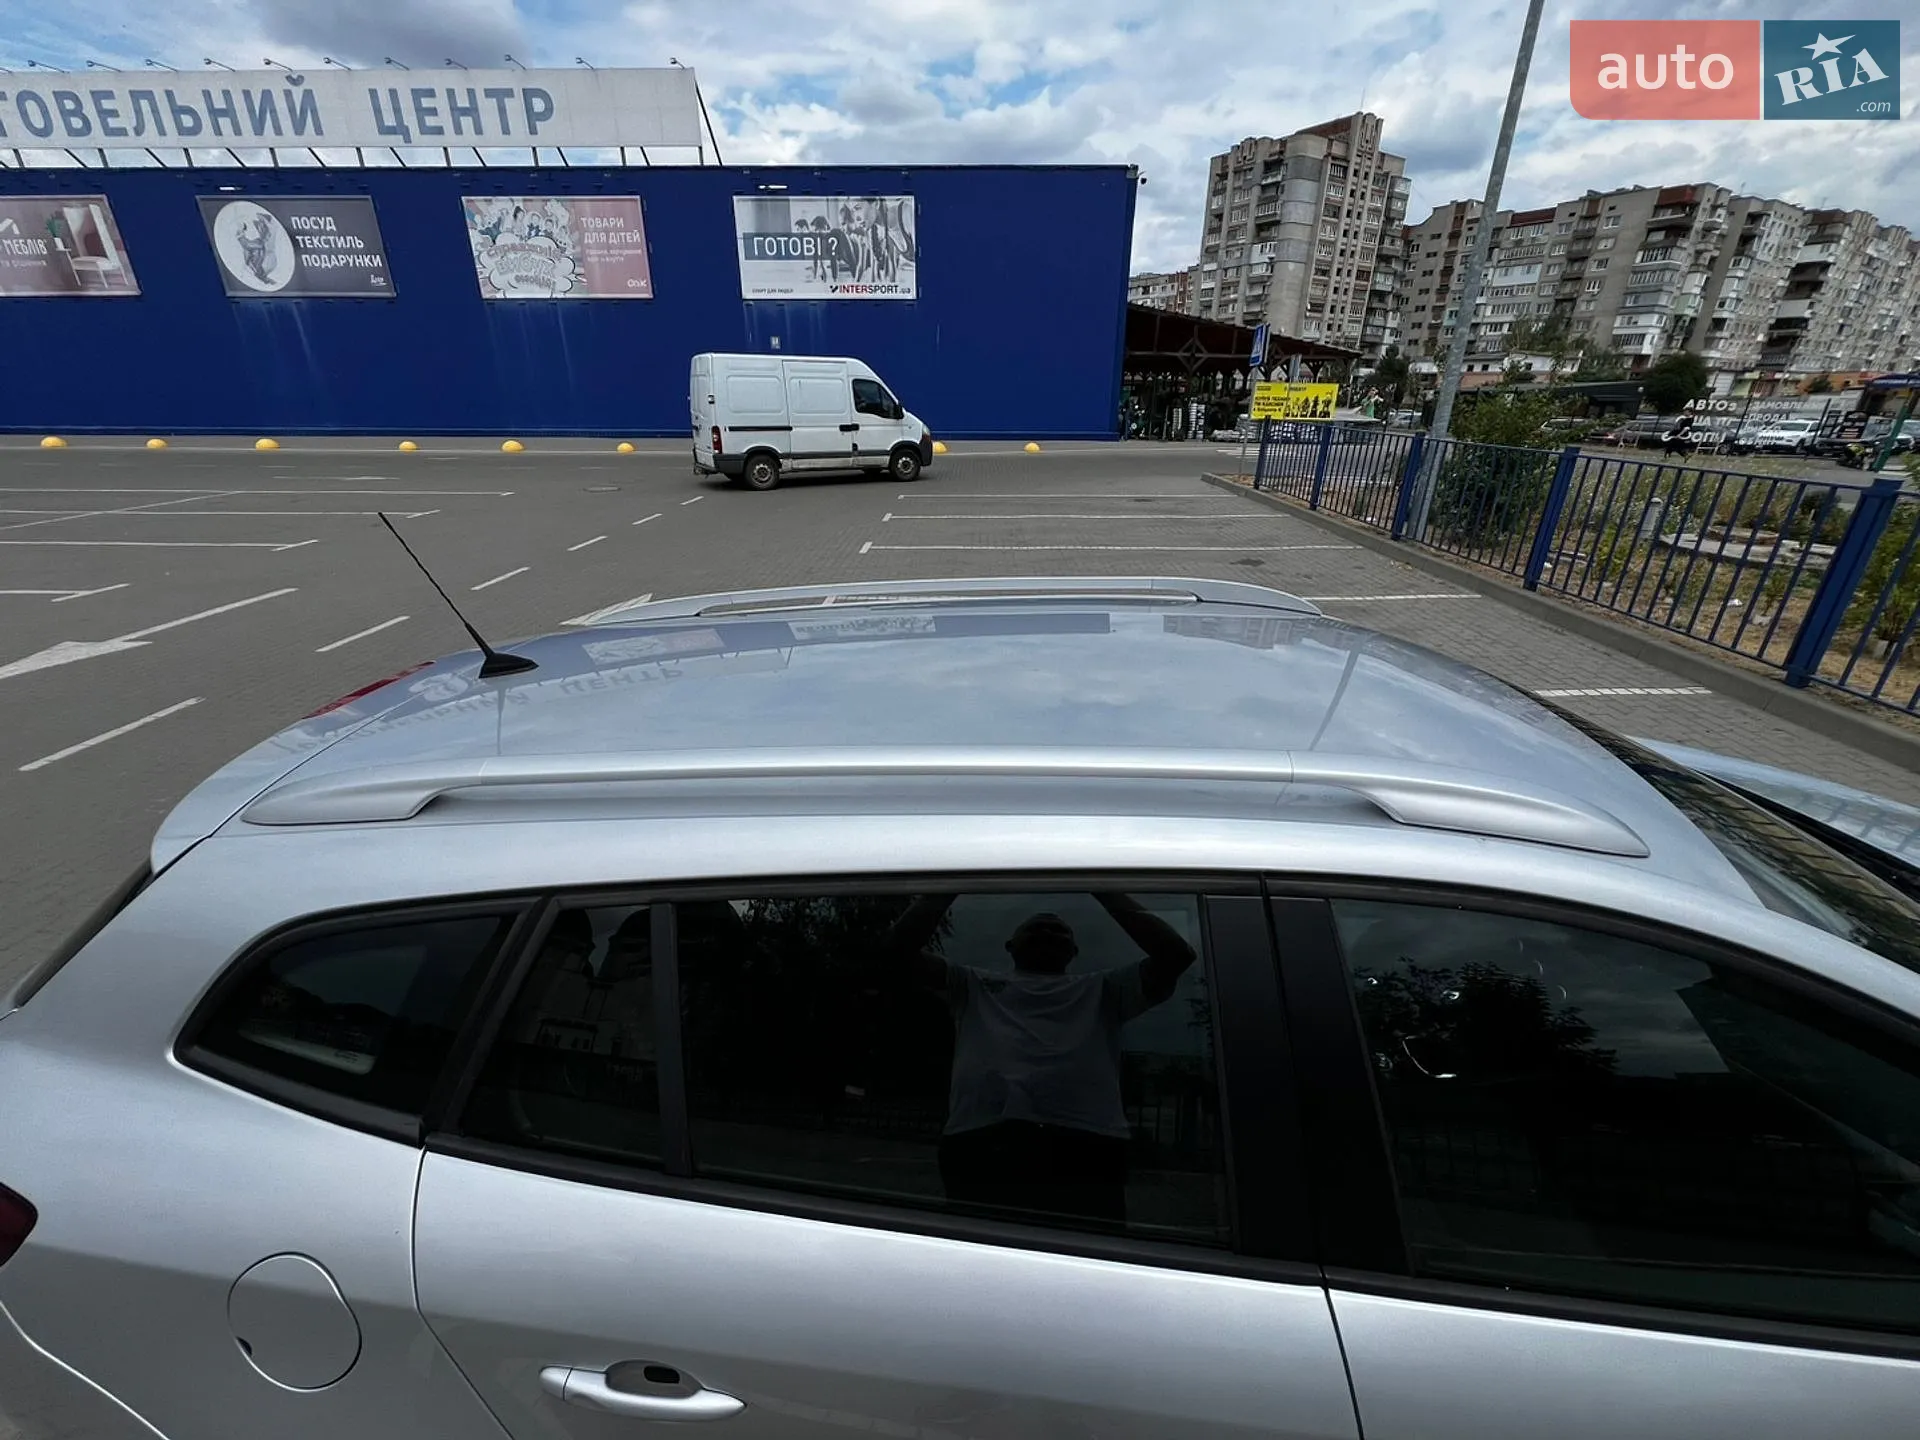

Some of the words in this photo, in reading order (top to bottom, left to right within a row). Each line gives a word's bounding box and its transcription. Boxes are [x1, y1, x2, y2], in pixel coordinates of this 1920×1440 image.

[367, 86, 556, 144] ЦЕНТР
[290, 216, 337, 231] ПОСУД
[580, 217, 624, 229] ТОВАРИ
[295, 235, 364, 249] ТЕКСТИЛЬ
[584, 231, 607, 244] ДЛЯ
[608, 229, 641, 244] ДІТЕЙ
[753, 236, 822, 256] ГОТОВІ
[828, 236, 839, 256] ?
[301, 254, 383, 268] ПОДАРУНКИ
